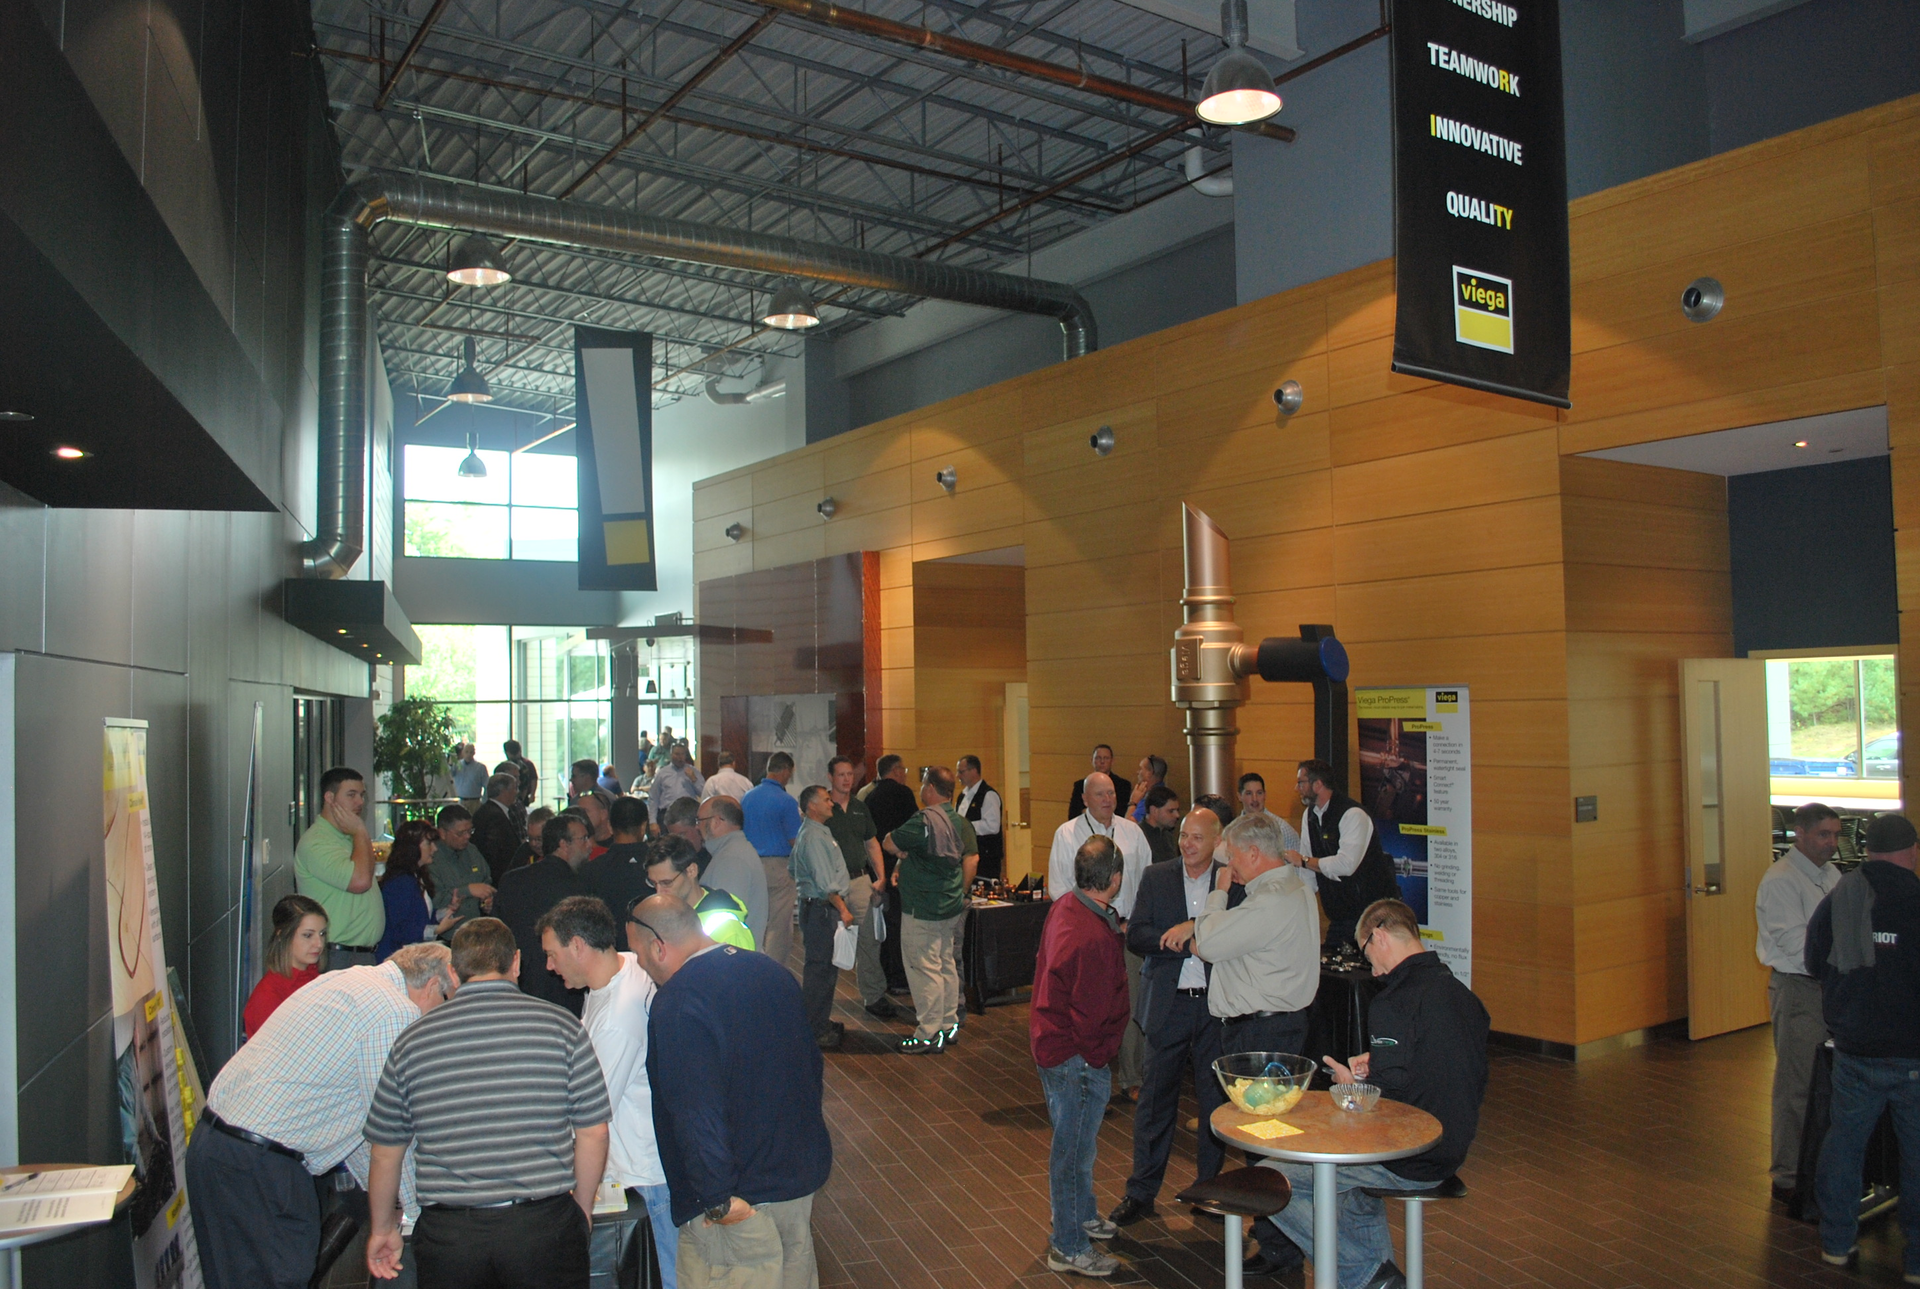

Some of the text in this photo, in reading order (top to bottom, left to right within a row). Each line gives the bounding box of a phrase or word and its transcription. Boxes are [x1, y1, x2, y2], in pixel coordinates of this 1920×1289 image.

[1452, 0, 1518, 28] ERSHIP
[1427, 42, 1520, 98] TEAMWORK
[1430, 114, 1523, 166] INNOVATIVE
[1446, 191, 1513, 230] QUALITY
[1461, 278, 1505, 311] viega
[1358, 696, 1376, 706] Viega
[1437, 692, 1457, 702] viega
[1401, 825, 1423, 833] ProPress
[1872, 932, 1897, 944] RIOT
